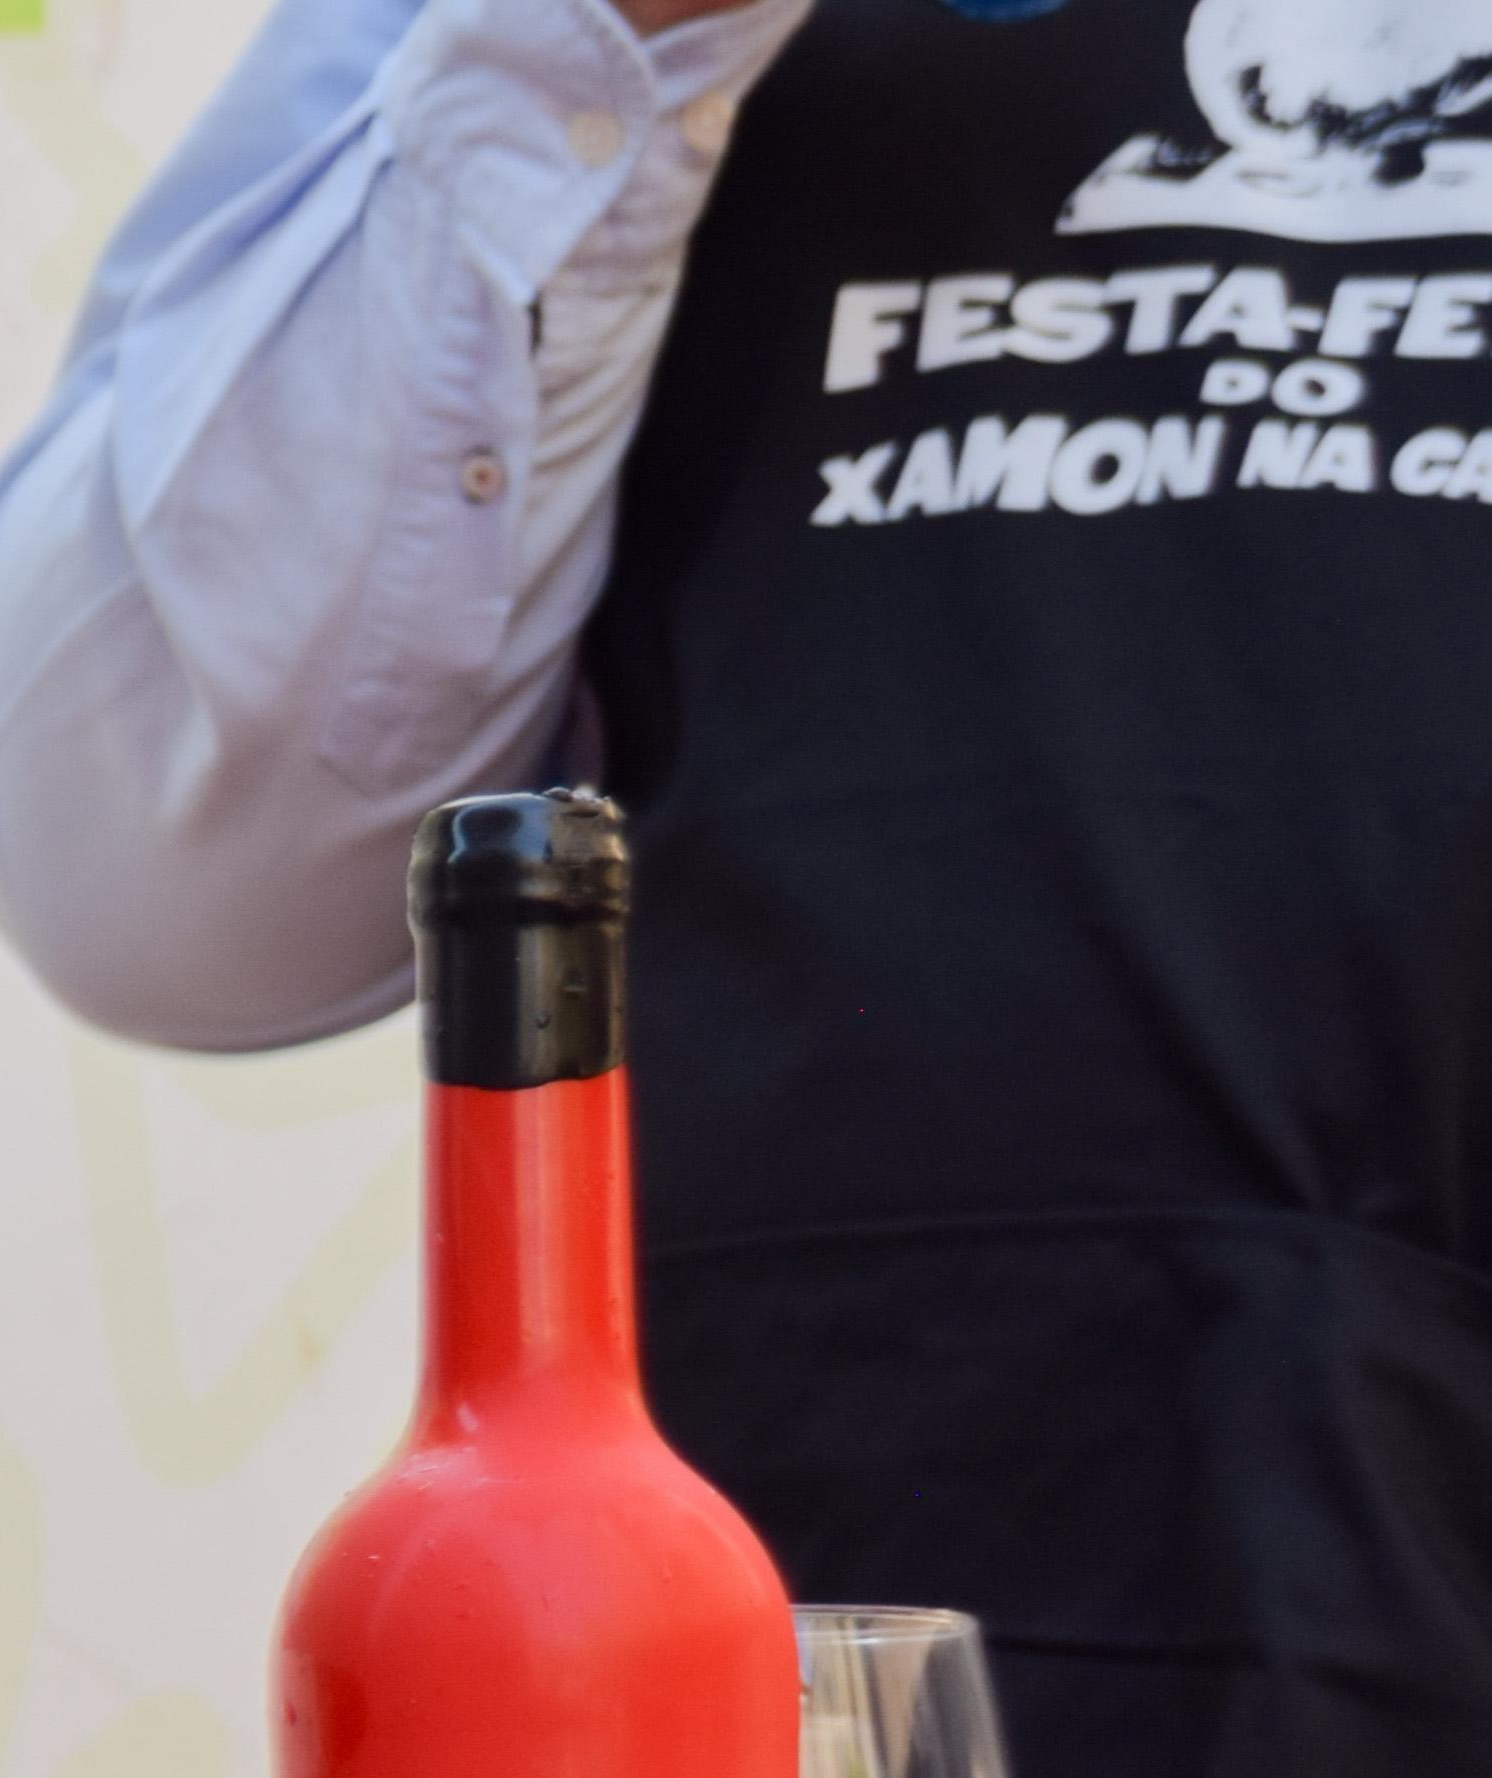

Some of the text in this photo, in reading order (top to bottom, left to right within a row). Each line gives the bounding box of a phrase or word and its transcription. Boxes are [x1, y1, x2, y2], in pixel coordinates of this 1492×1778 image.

[1200, 358, 1364, 418] DO
[810, 413, 1224, 527] XAMON
[1235, 417, 1374, 492] NA
